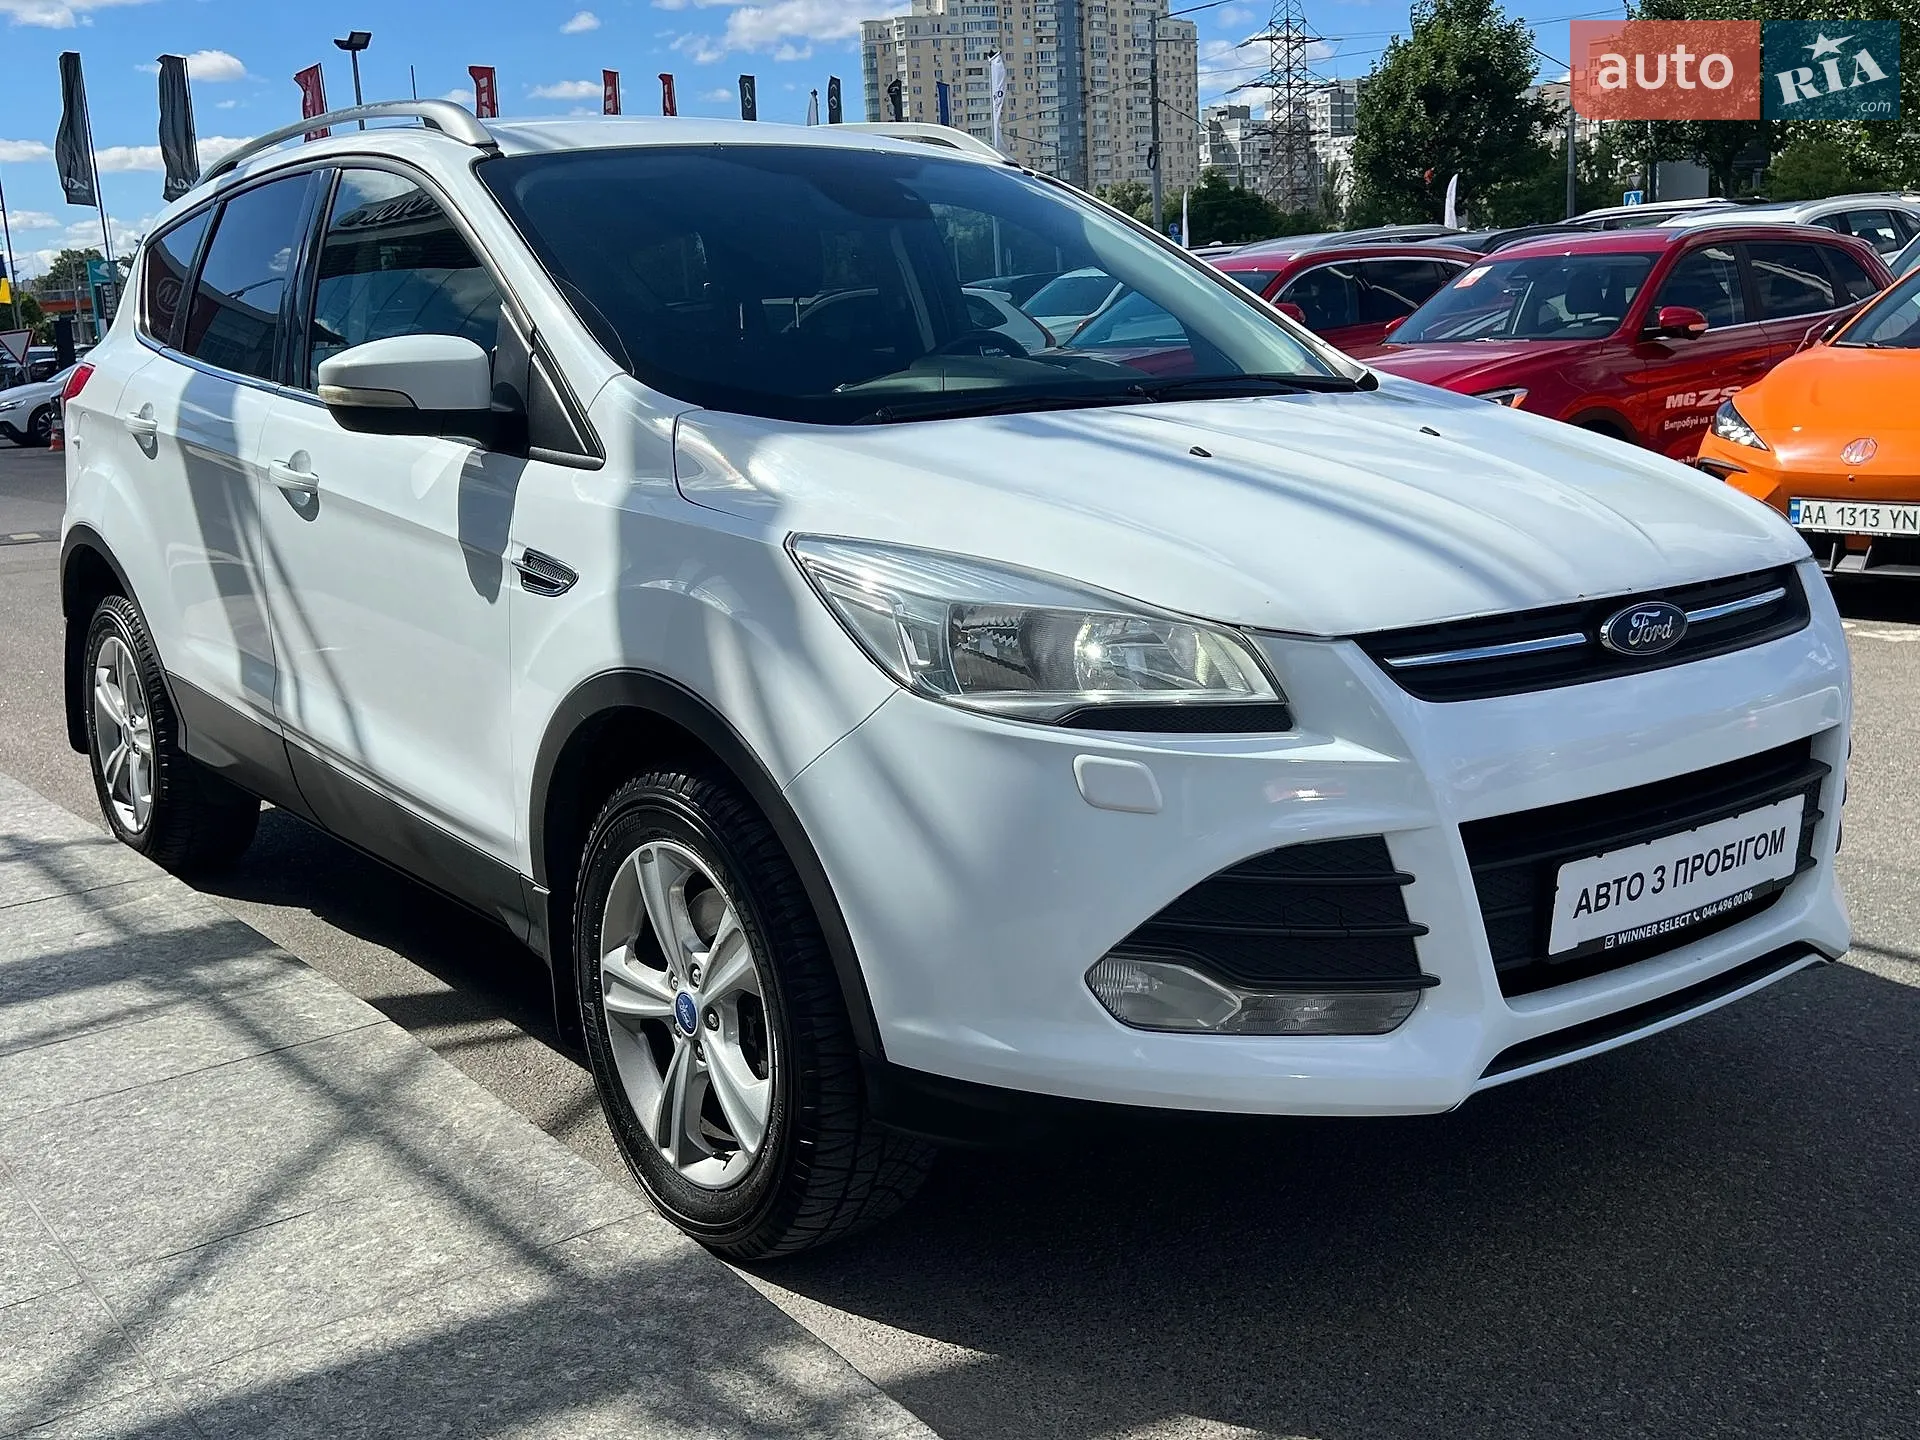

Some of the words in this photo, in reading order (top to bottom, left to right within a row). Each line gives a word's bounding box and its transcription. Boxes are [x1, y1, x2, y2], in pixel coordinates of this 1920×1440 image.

[1665, 392, 1696, 409] MG
[1801, 505, 1827, 524] AA
[1836, 507, 1880, 527] 1313
[1889, 509, 1918, 530] YN
[1628, 611, 1674, 646] Ford
[1572, 871, 1645, 919] АВТО
[1672, 826, 1786, 888] ПРОБІГОМ
[1618, 923, 1658, 945] WINNER
[1659, 913, 1692, 934] SELECT
[1702, 904, 1718, 919] 044
[1718, 899, 1733, 912] 496
[677, 998, 693, 1029] Ford
